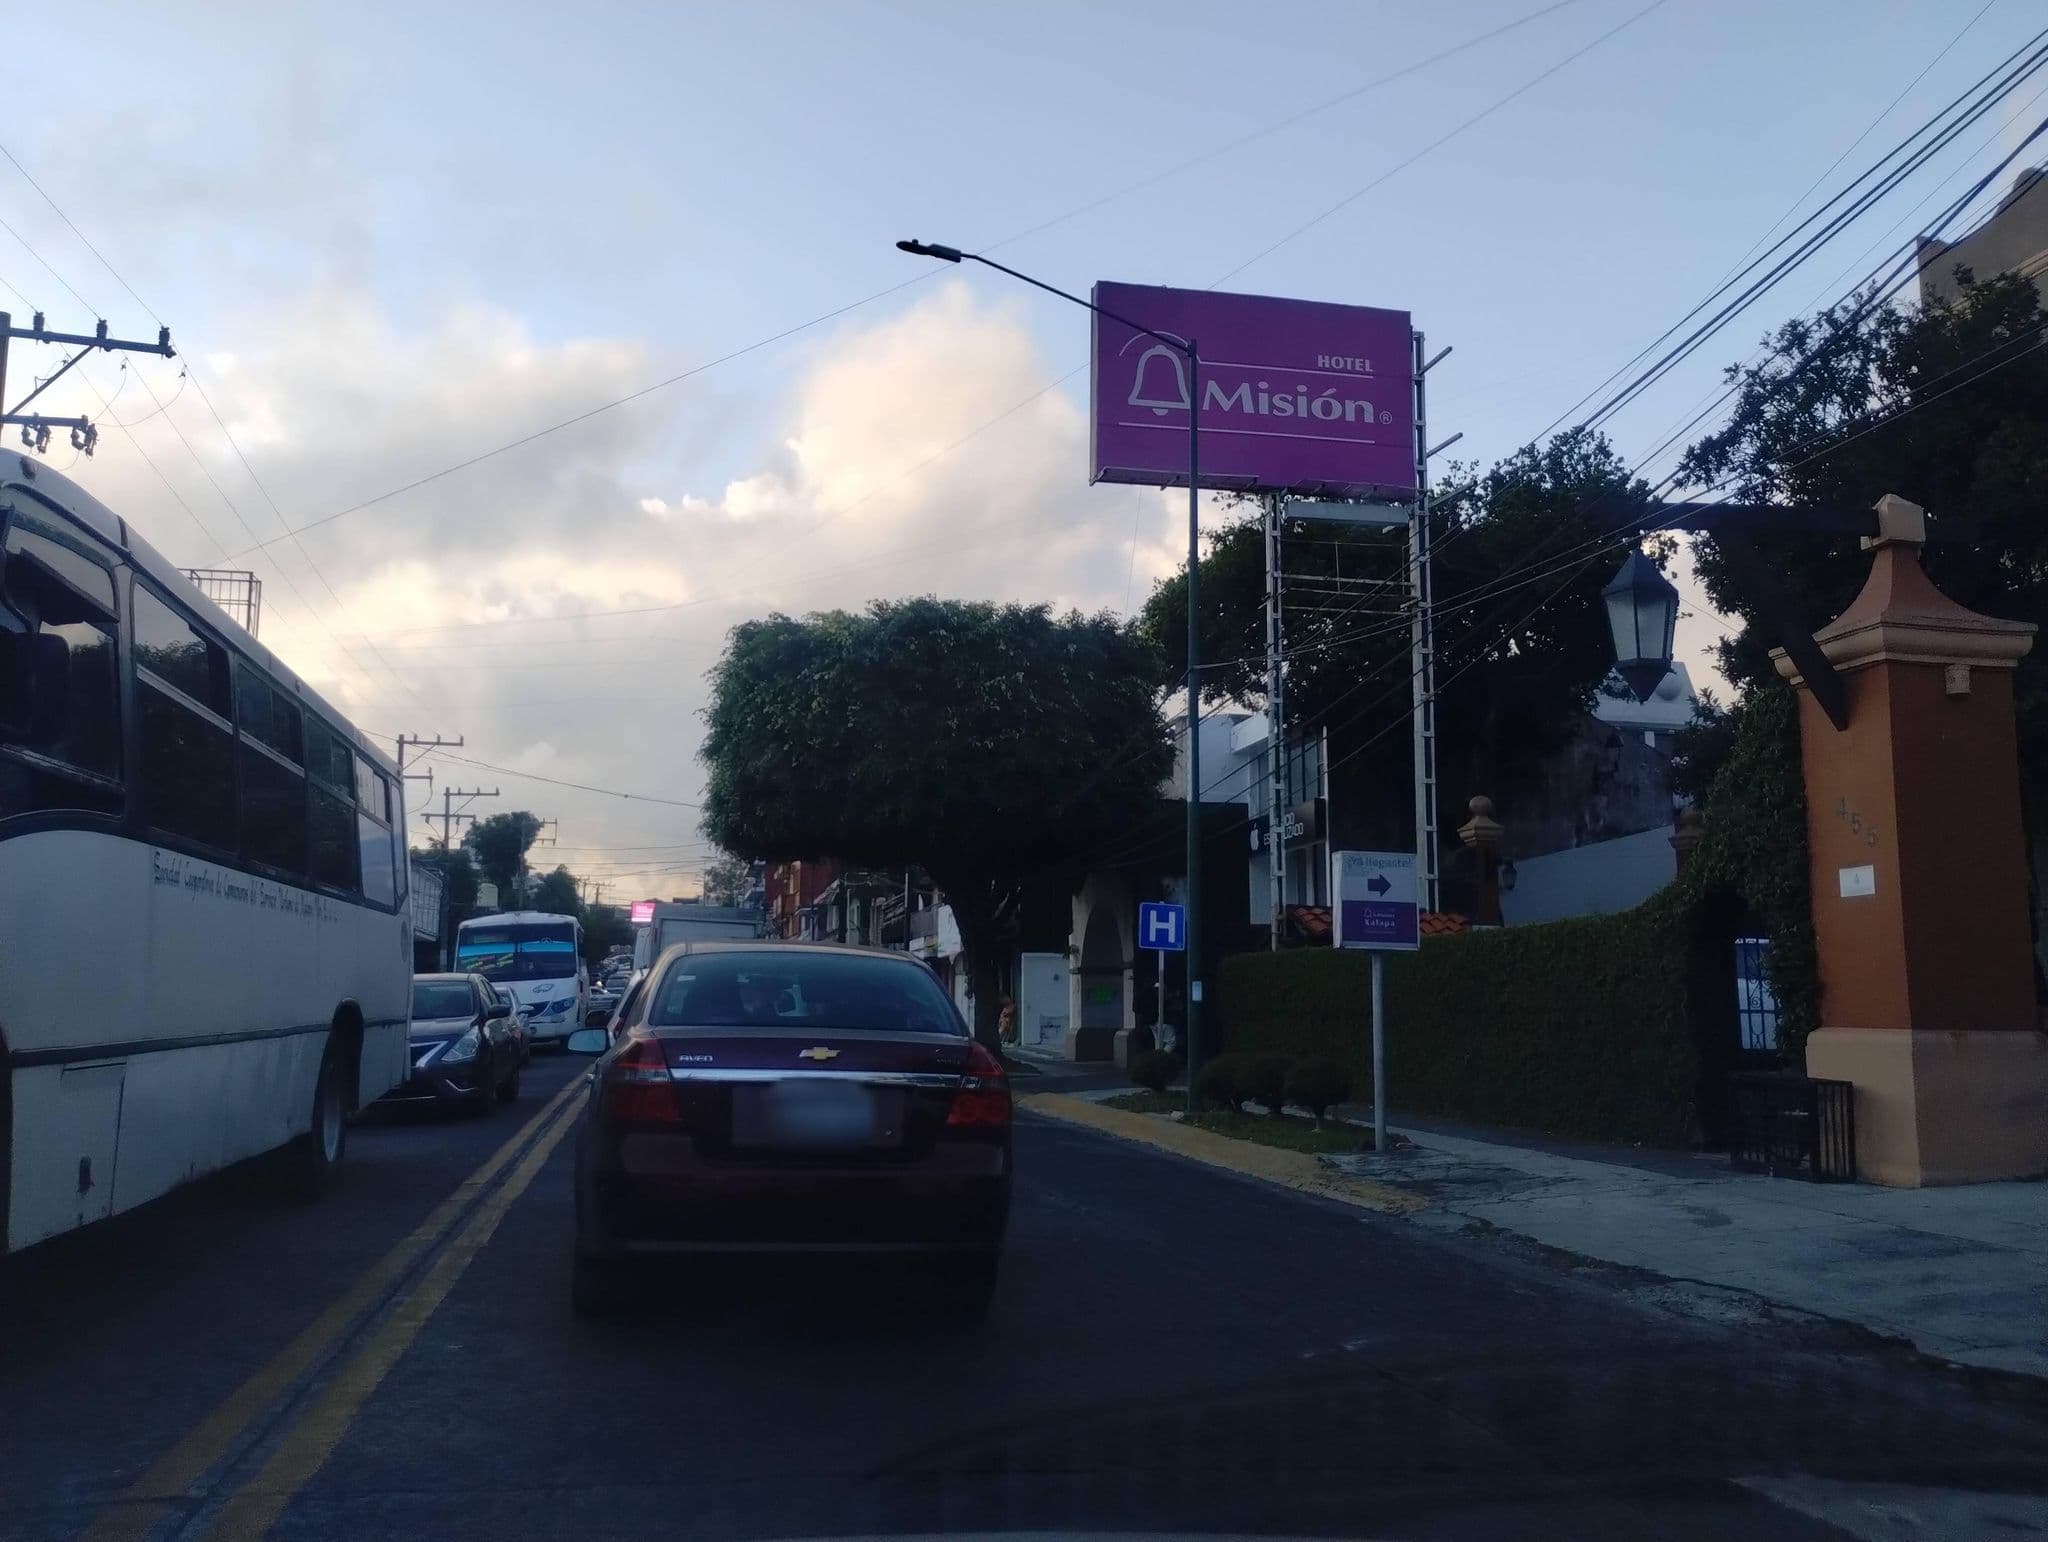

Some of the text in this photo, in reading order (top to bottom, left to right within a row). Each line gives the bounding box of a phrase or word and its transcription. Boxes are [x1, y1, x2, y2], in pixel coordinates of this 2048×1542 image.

[1317, 354, 1374, 373] HOTEL
[1202, 380, 1375, 424] Misión
[1150, 910, 1176, 943] H
